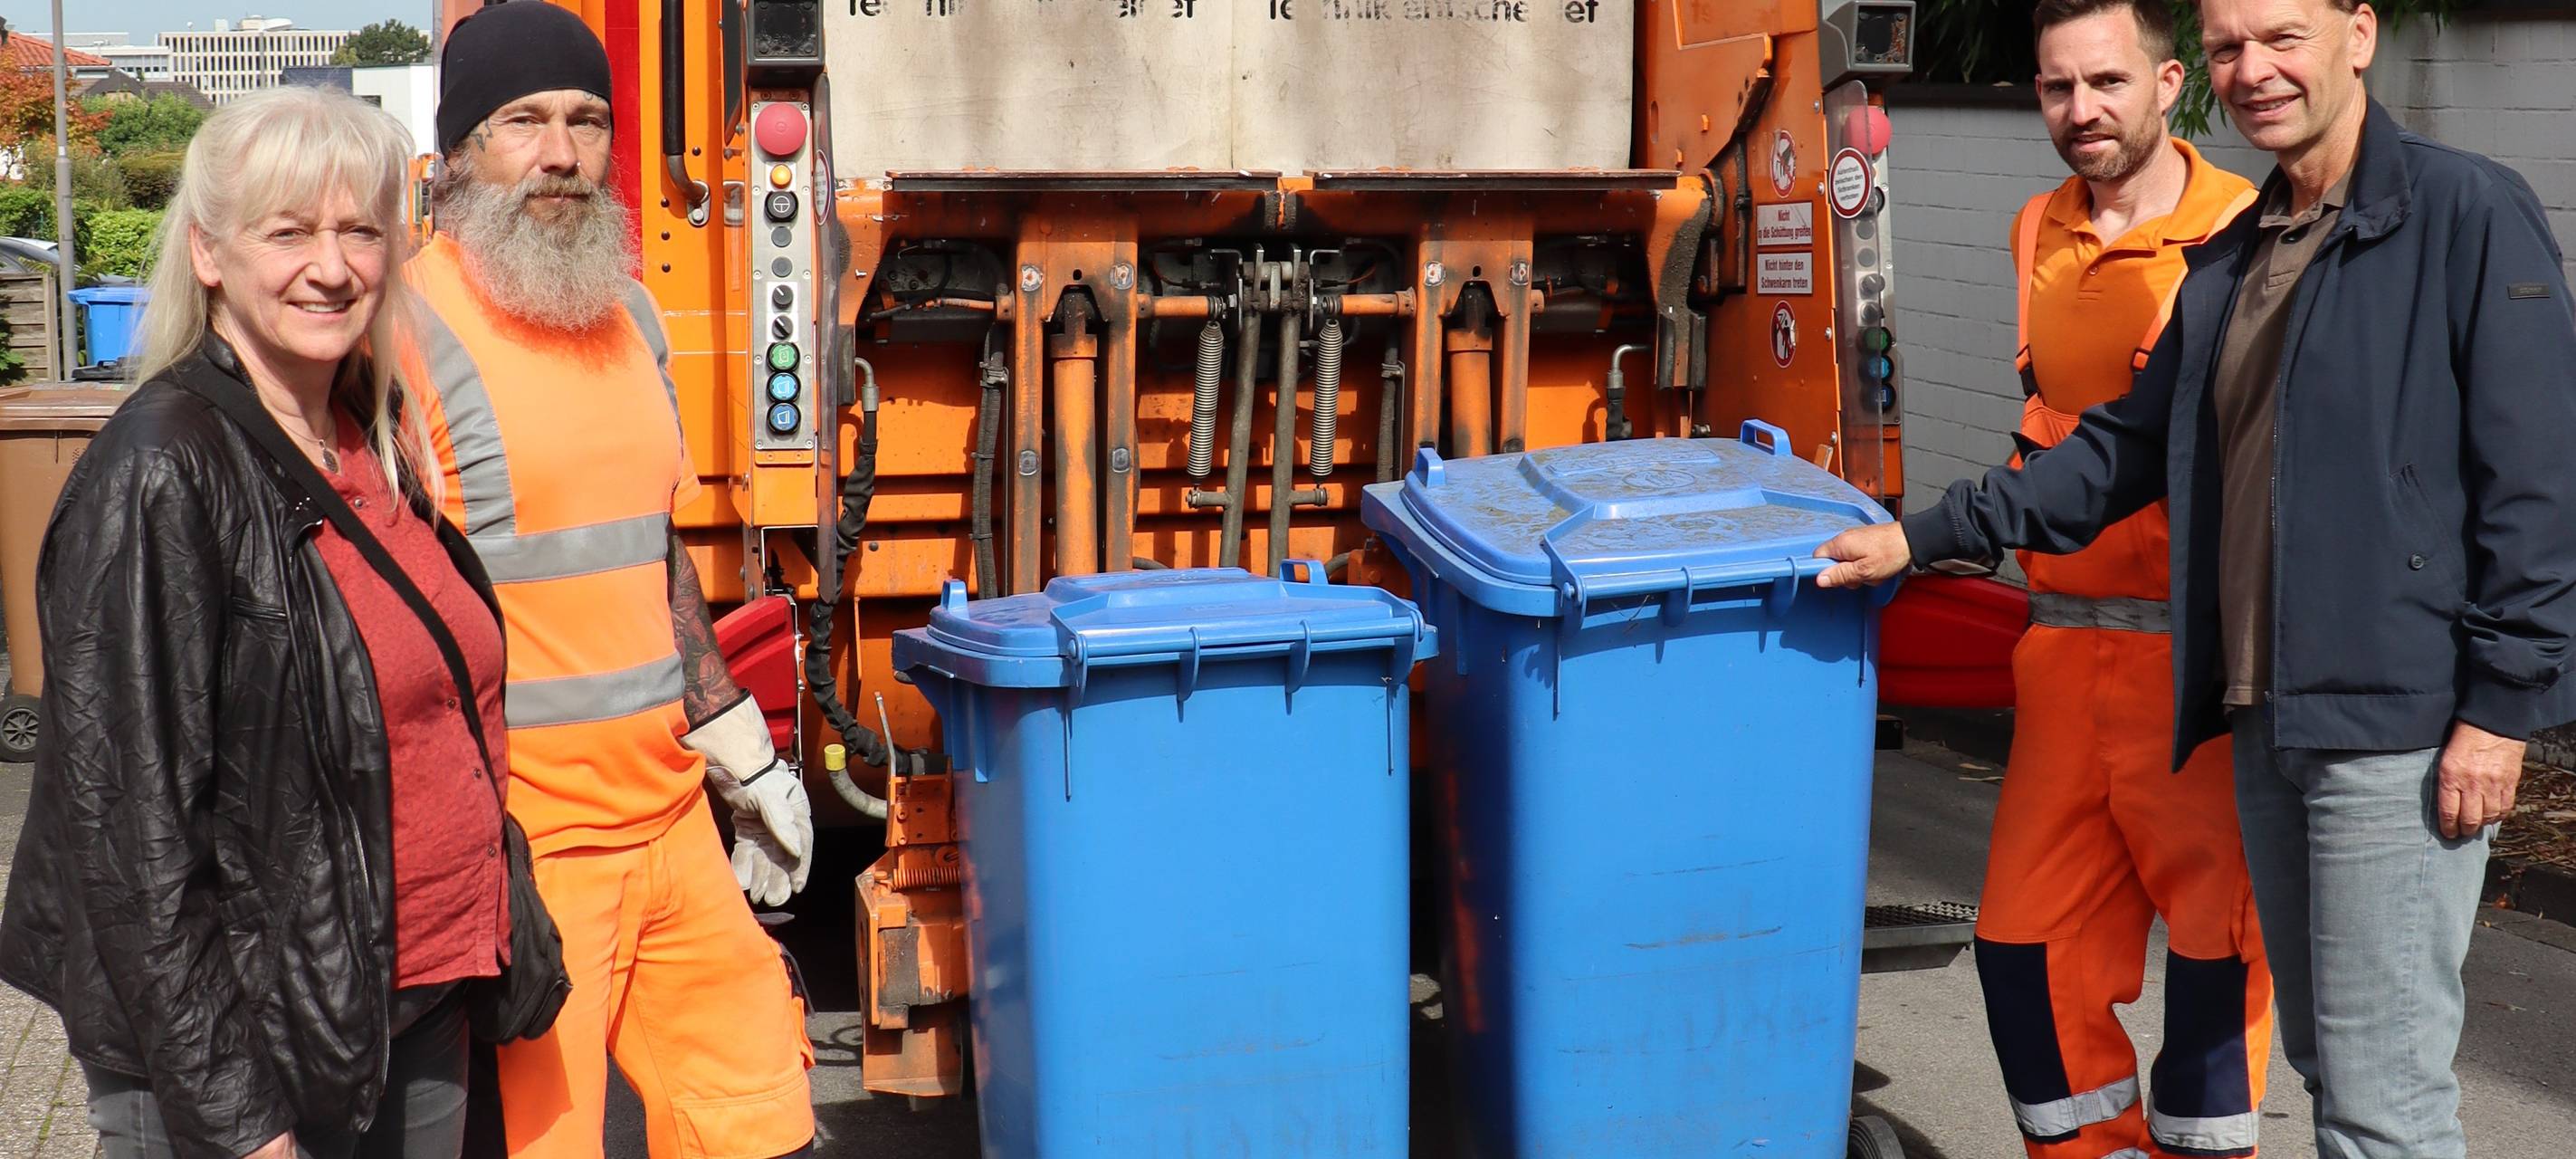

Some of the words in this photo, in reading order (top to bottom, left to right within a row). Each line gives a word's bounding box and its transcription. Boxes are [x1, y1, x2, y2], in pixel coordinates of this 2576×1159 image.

[1778, 210, 1790, 221] Nicht
[1795, 225, 1811, 239] greifen
[1765, 259, 1778, 271] Nicht
[1779, 259, 1793, 270] hinter
[1794, 259, 1804, 270] den
[1761, 276, 1792, 288] Schwenkarm
[1793, 277, 1808, 288] treten
